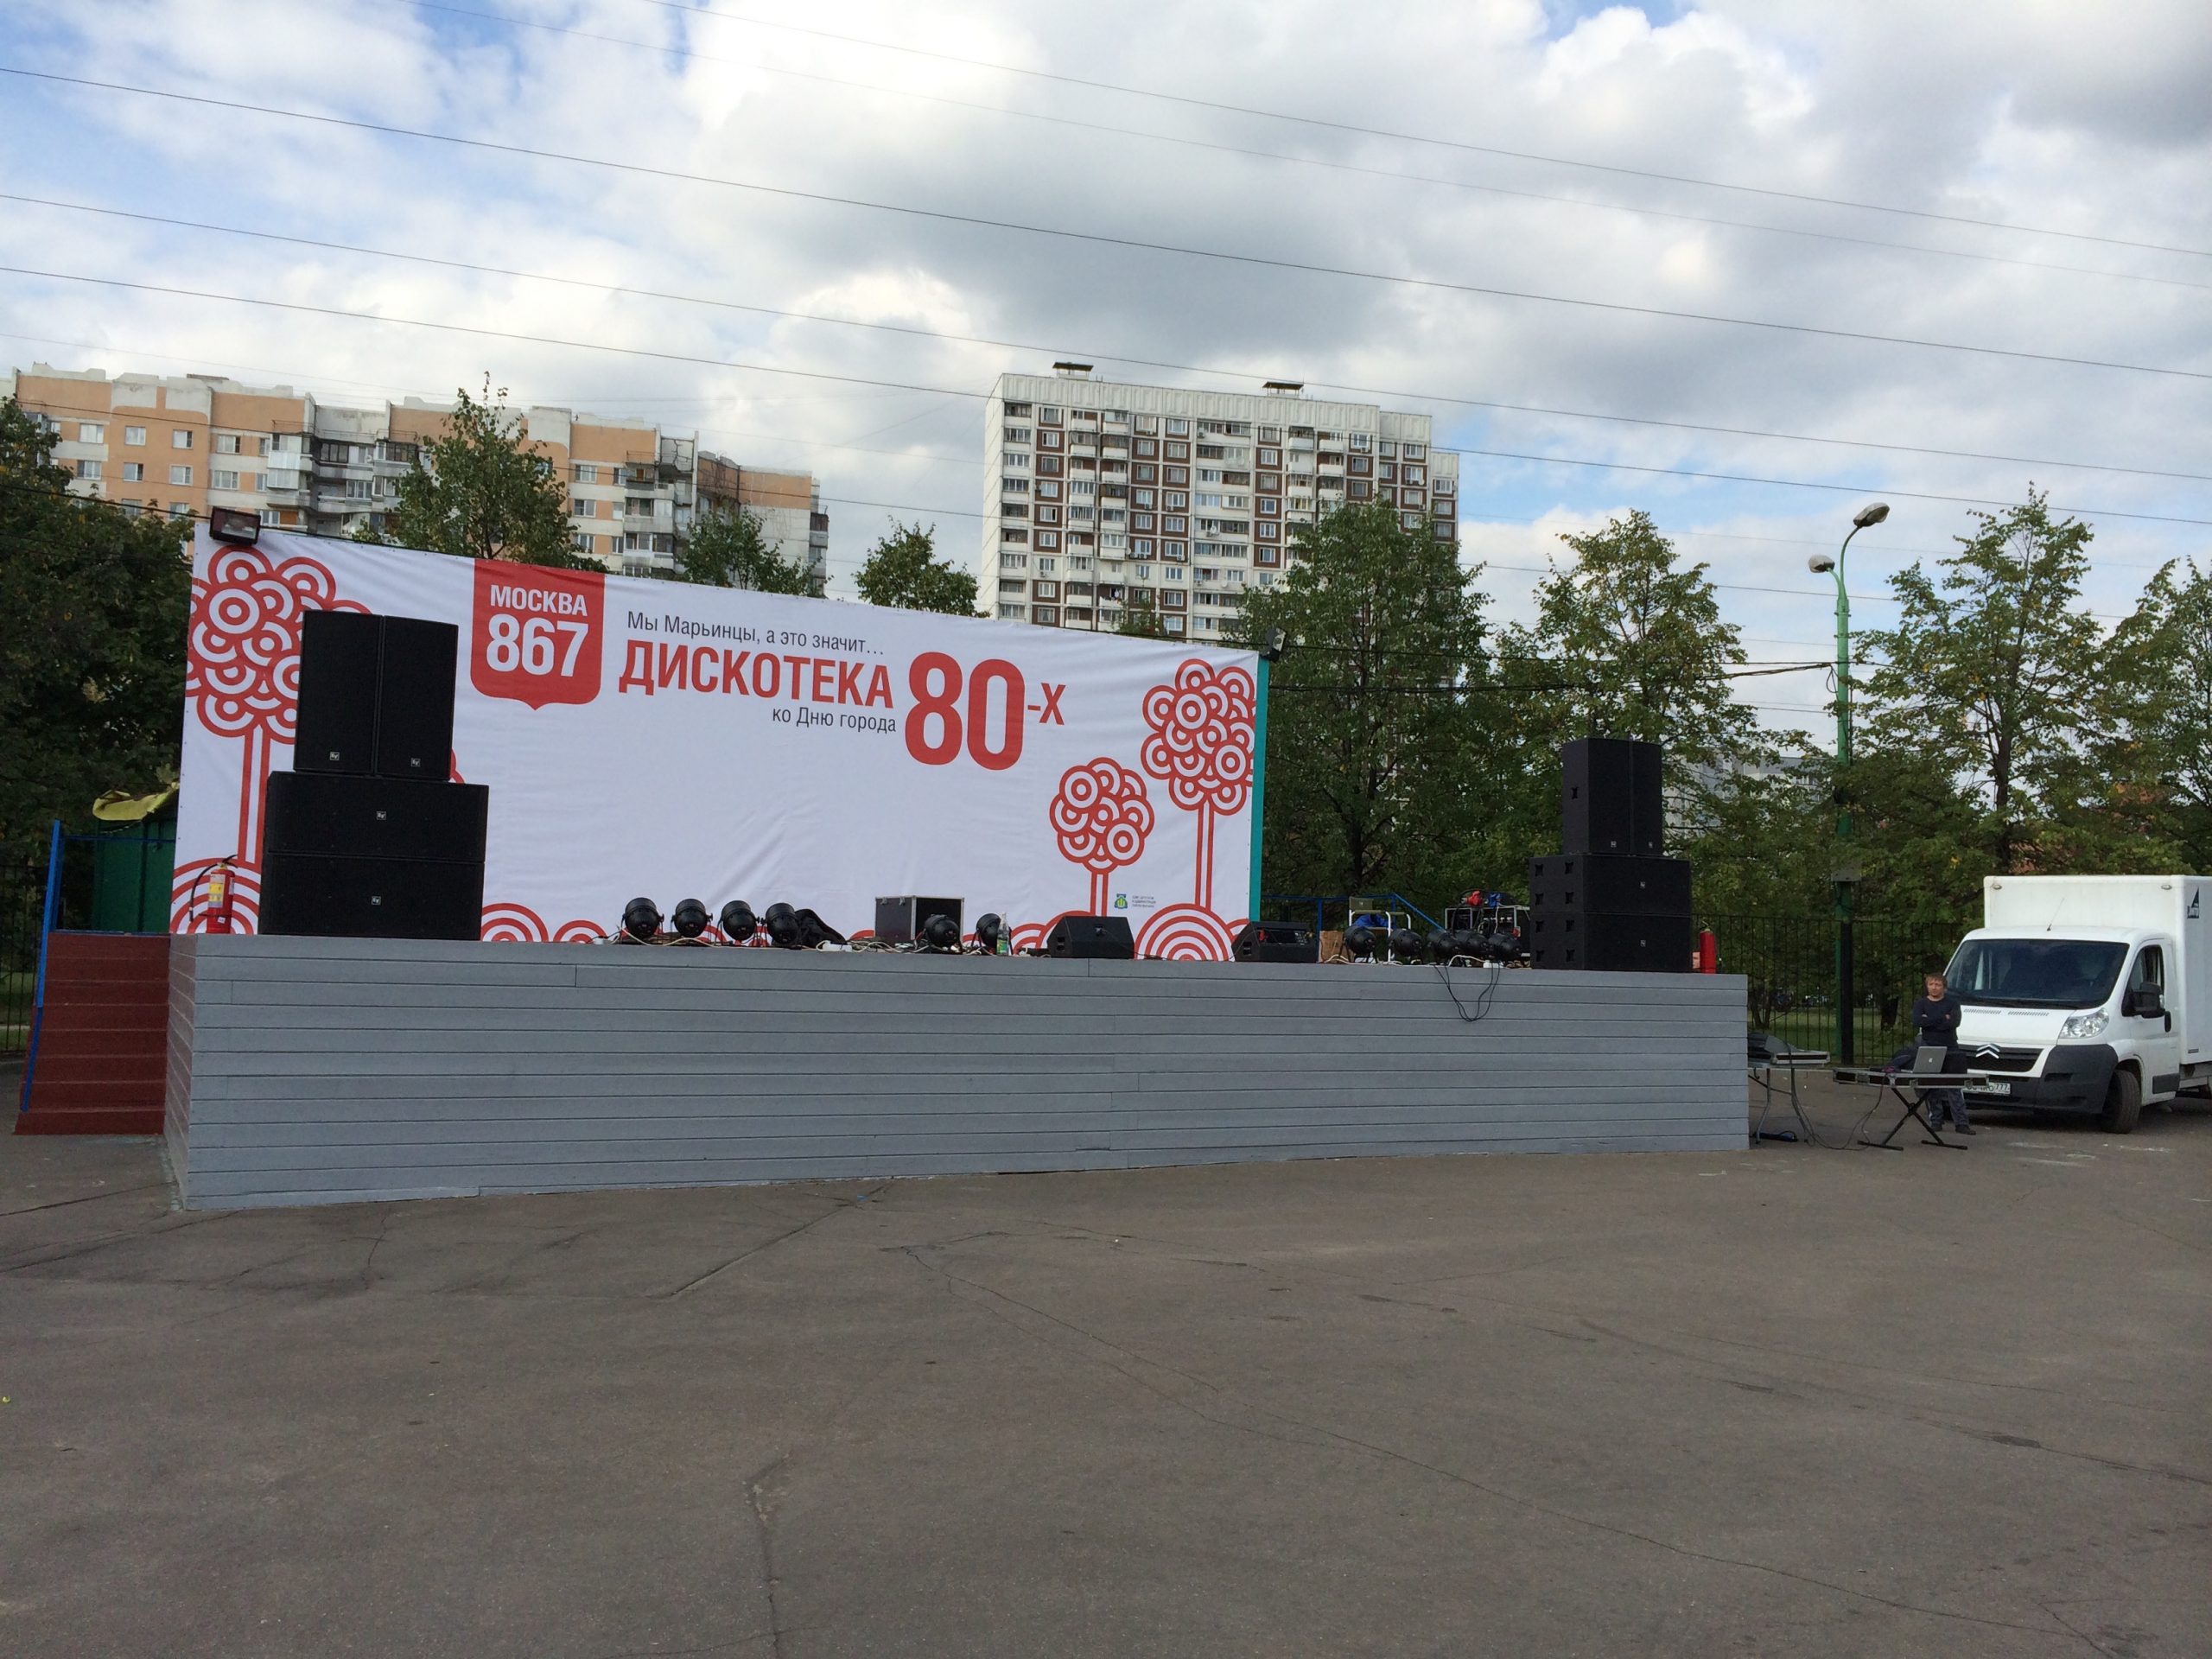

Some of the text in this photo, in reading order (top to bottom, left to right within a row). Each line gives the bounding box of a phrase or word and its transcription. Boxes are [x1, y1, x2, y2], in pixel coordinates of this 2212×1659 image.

[490, 584, 588, 616] МОСКВА
[486, 613, 589, 677] 867
[627, 611, 658, 632] Мы
[664, 614, 760, 645] Марьинцы,
[766, 629, 775, 644] а
[780, 631, 807, 647] это
[619, 639, 893, 709] ДИСКОТЕКА
[772, 707, 896, 734] ко Дню города
